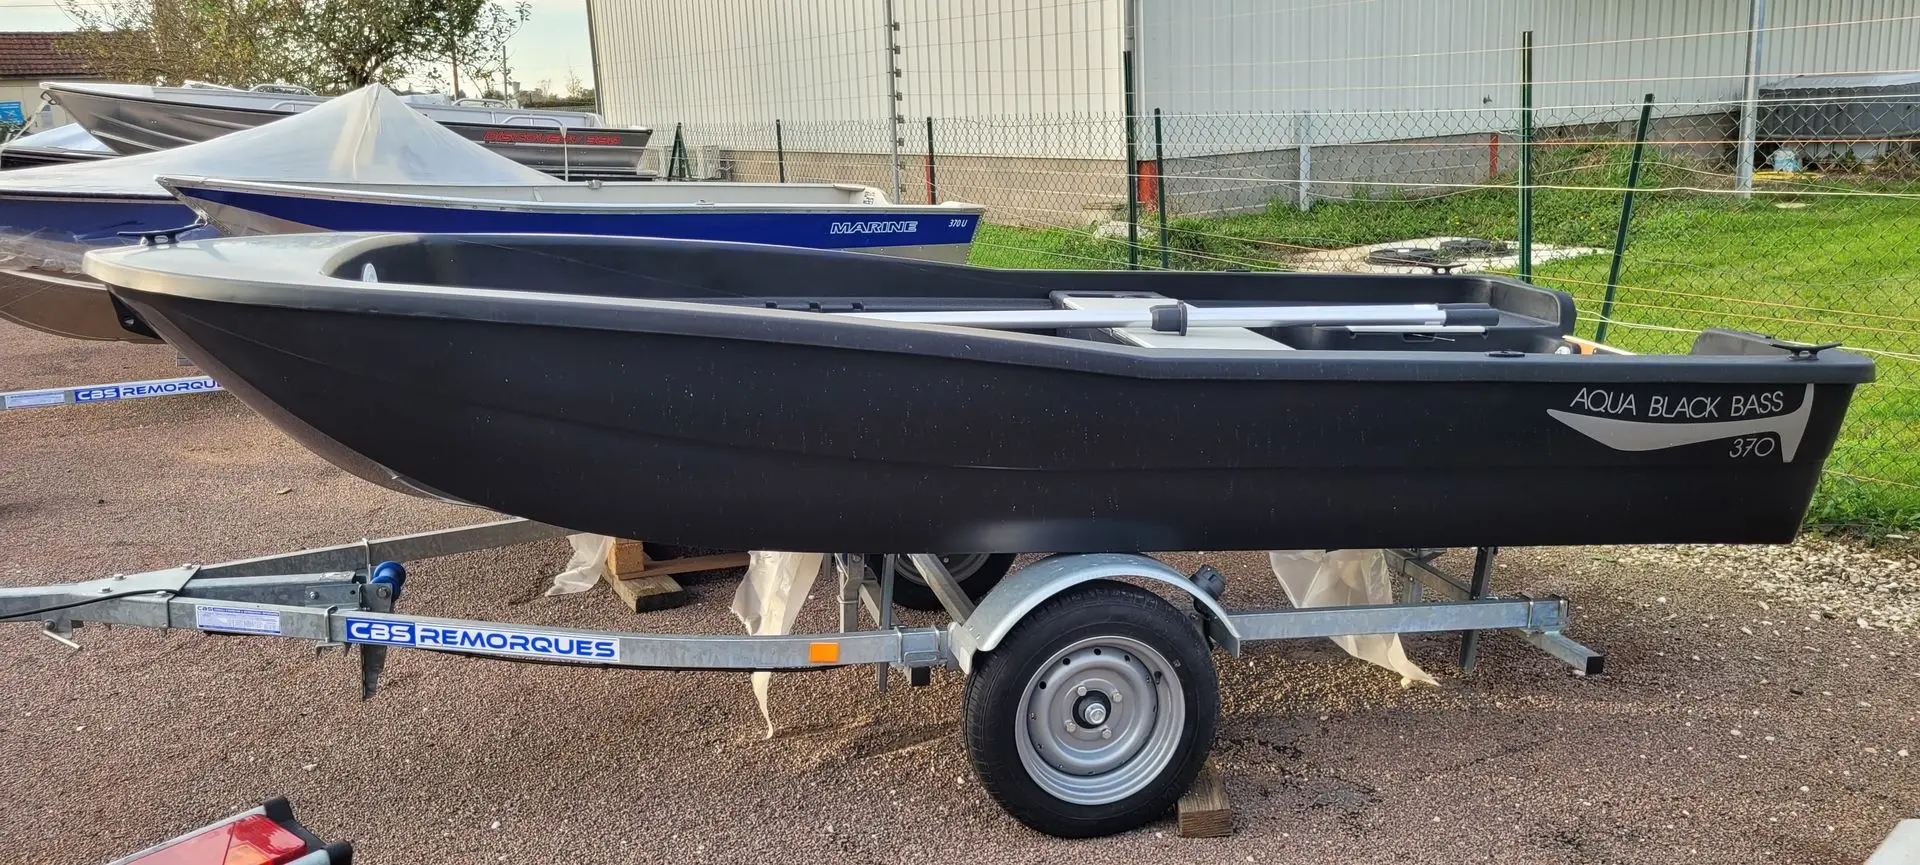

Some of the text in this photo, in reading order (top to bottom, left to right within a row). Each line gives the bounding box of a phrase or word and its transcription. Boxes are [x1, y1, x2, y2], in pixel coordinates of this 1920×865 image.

[830, 220, 919, 234] MARINE
[948, 219, 962, 228] 370
[77, 386, 119, 401] CBS
[122, 380, 222, 397] REMORQU
[1569, 387, 1784, 418] AQUA BLACK BASS
[1729, 437, 1775, 458] 370
[350, 622, 616, 658] CBS REMORQUES
